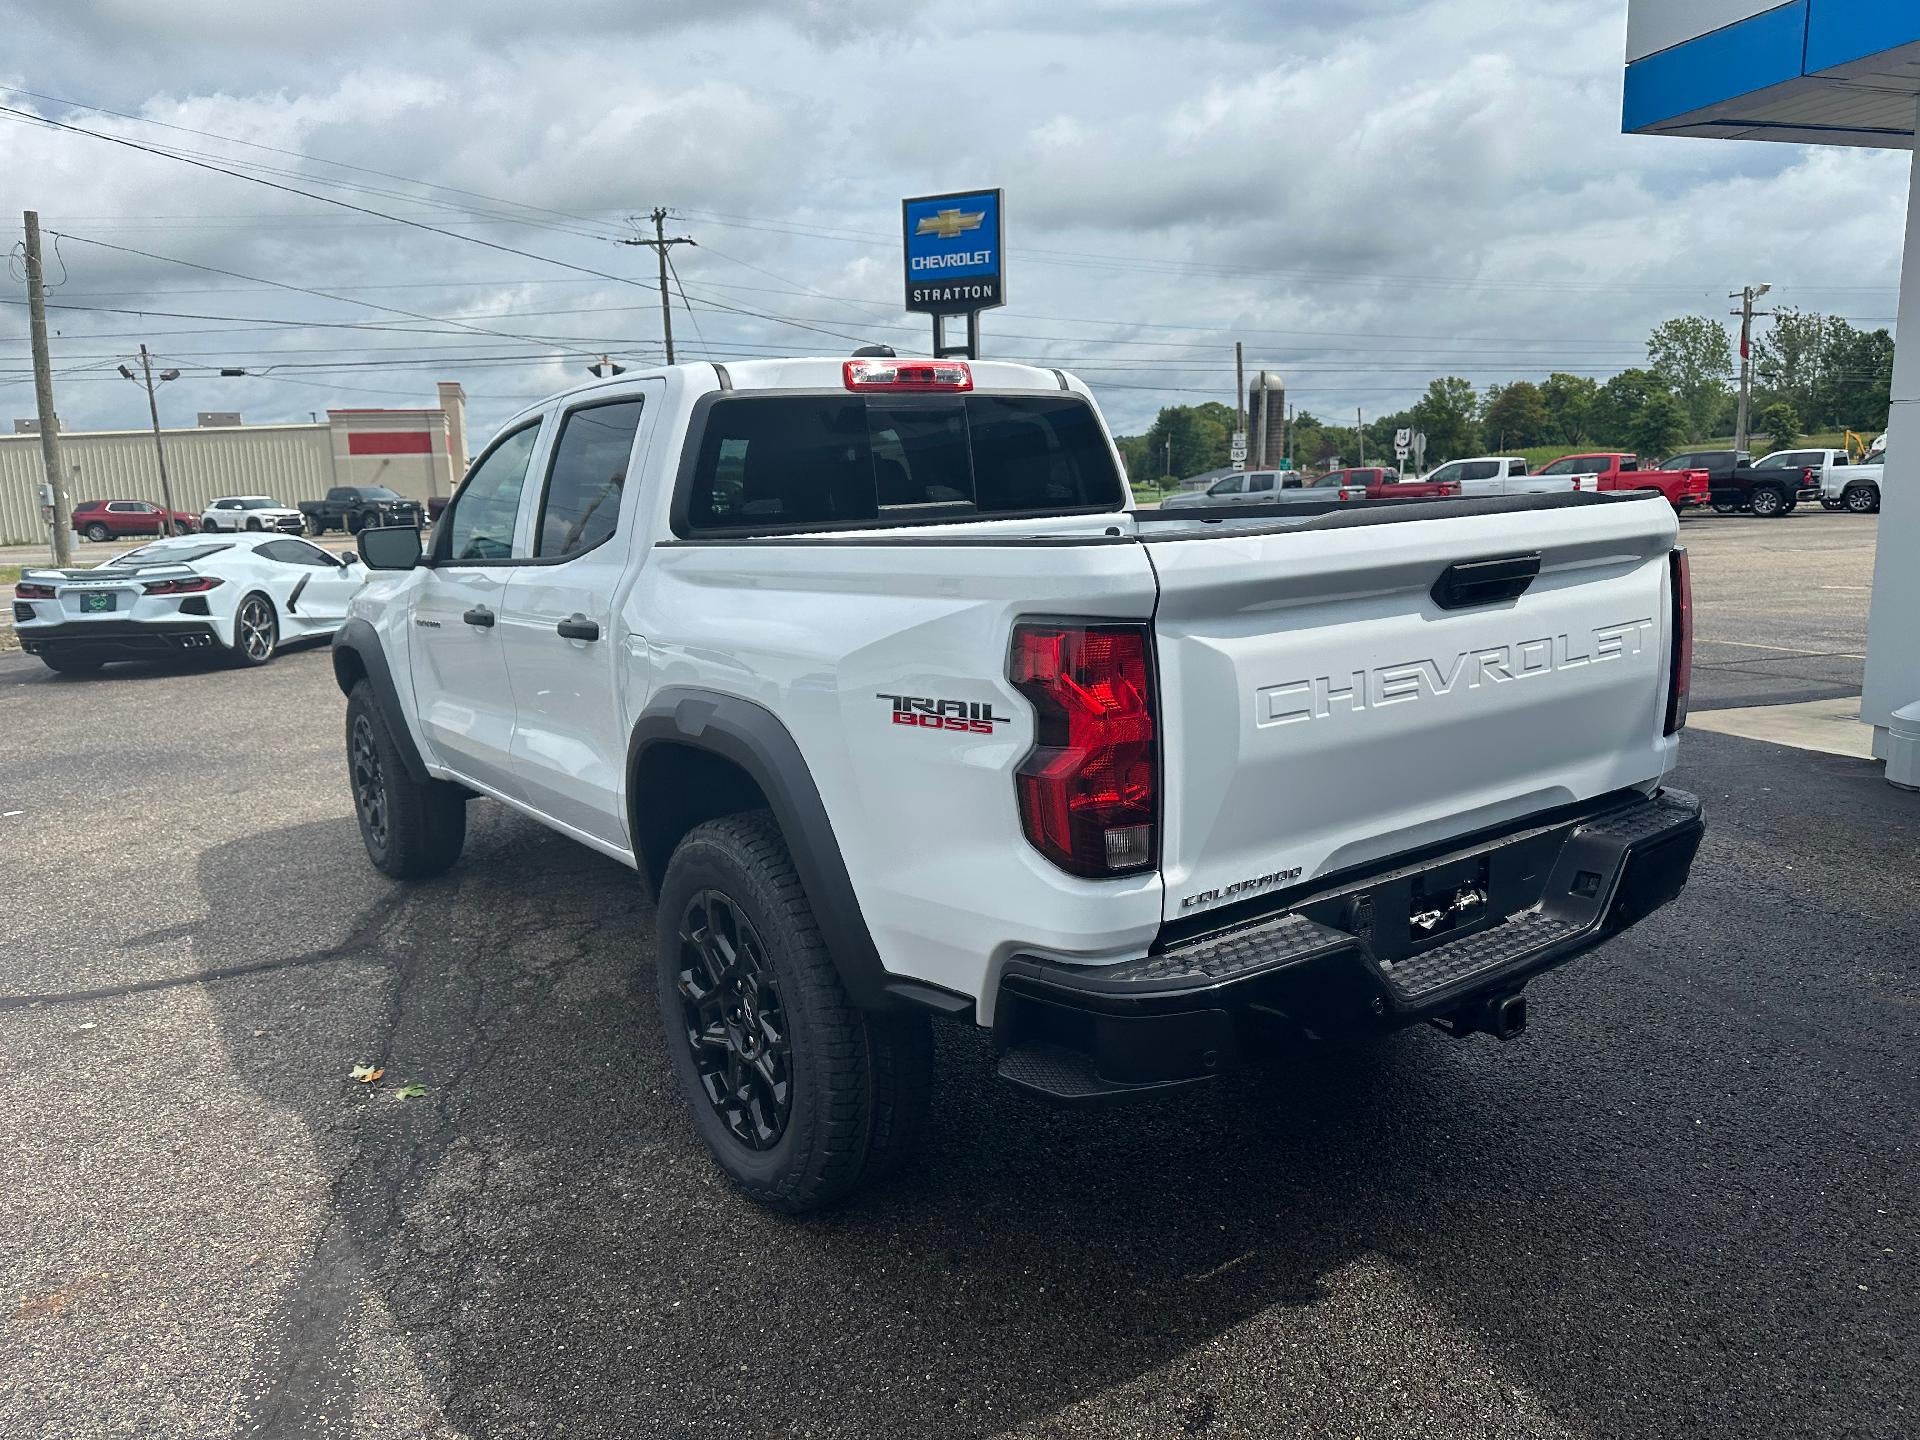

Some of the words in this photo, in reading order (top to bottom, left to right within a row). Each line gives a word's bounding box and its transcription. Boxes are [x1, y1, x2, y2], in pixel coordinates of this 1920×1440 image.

[911, 250, 992, 270] CHEVROLET
[913, 284, 993, 302] STRATTON
[1255, 617, 1653, 729] CHEVROLET
[876, 692, 1011, 723] TRAIL
[892, 711, 994, 735] BOSS
[1181, 866, 1303, 907] COLORADO
